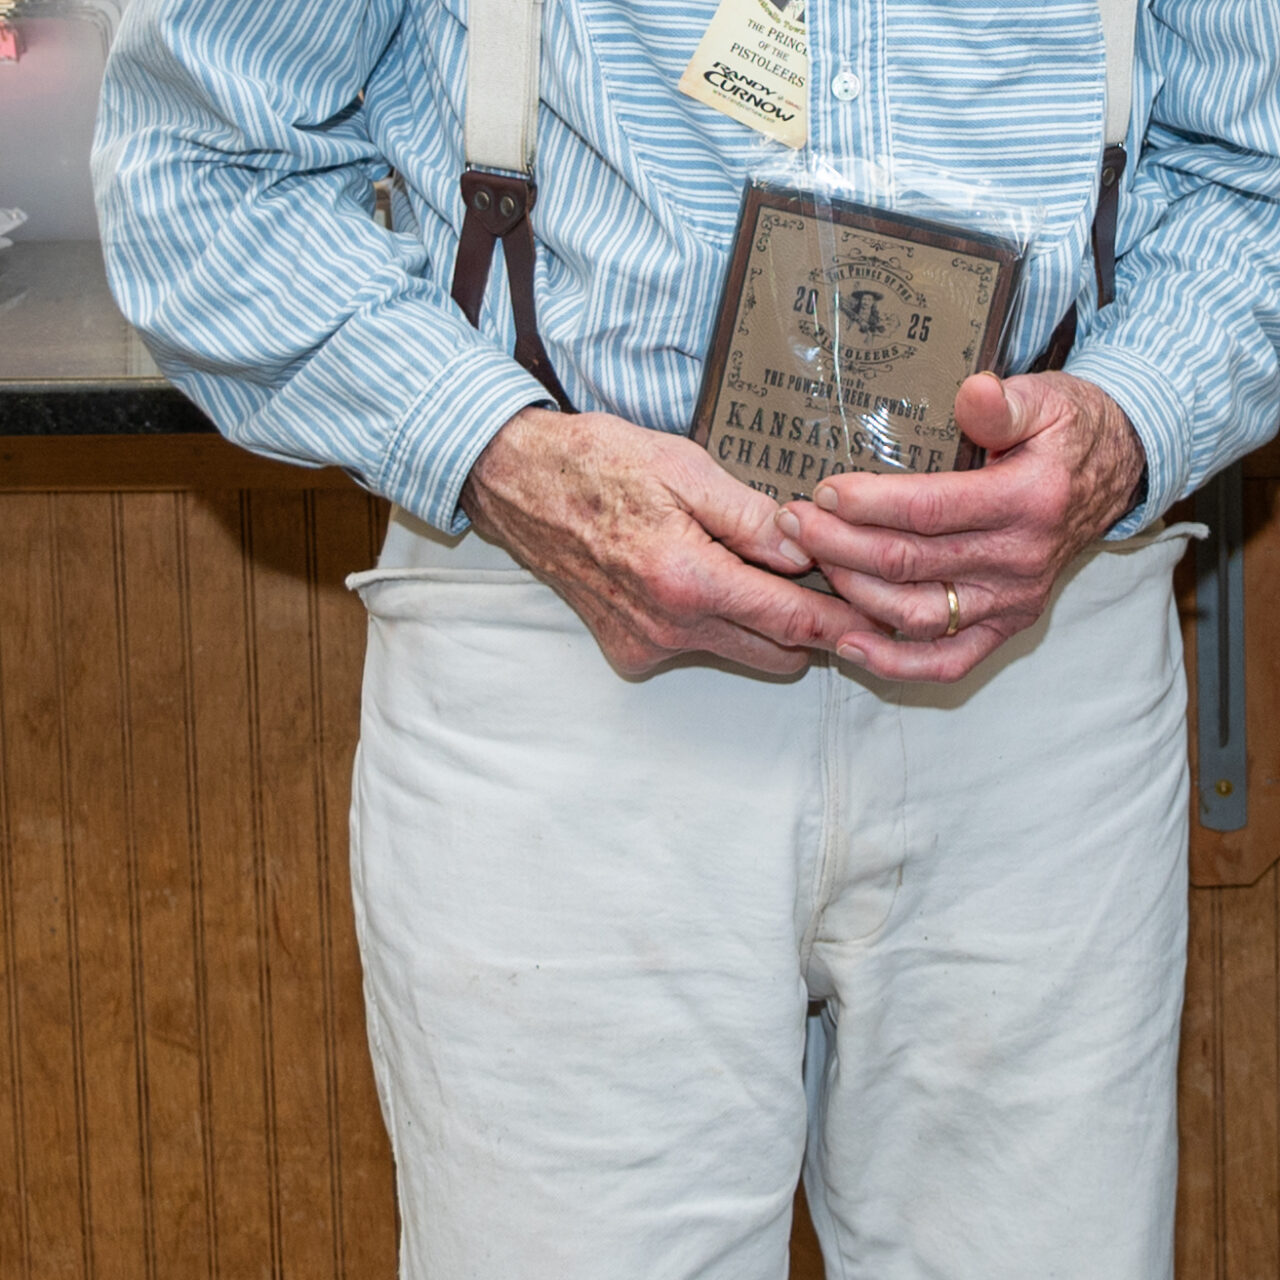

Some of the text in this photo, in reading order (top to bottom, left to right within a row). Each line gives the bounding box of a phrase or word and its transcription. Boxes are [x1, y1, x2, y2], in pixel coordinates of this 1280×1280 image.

[746, 17, 766, 35] THE
[729, 42, 806, 88] PISTOLEERS
[757, 40, 790, 62] OF THE
[703, 70, 795, 122] CURNOW
[712, 61, 778, 96] RANDY
[793, 285, 819, 316] 20
[826, 265, 913, 302] THE PRINCE OF THE
[906, 312, 932, 342] 25
[763, 368, 928, 422] THE POWDER CREEK COWBOYS
[725, 399, 945, 473] KANSAS STATE
[718, 433, 882, 482] CHAMPIO
